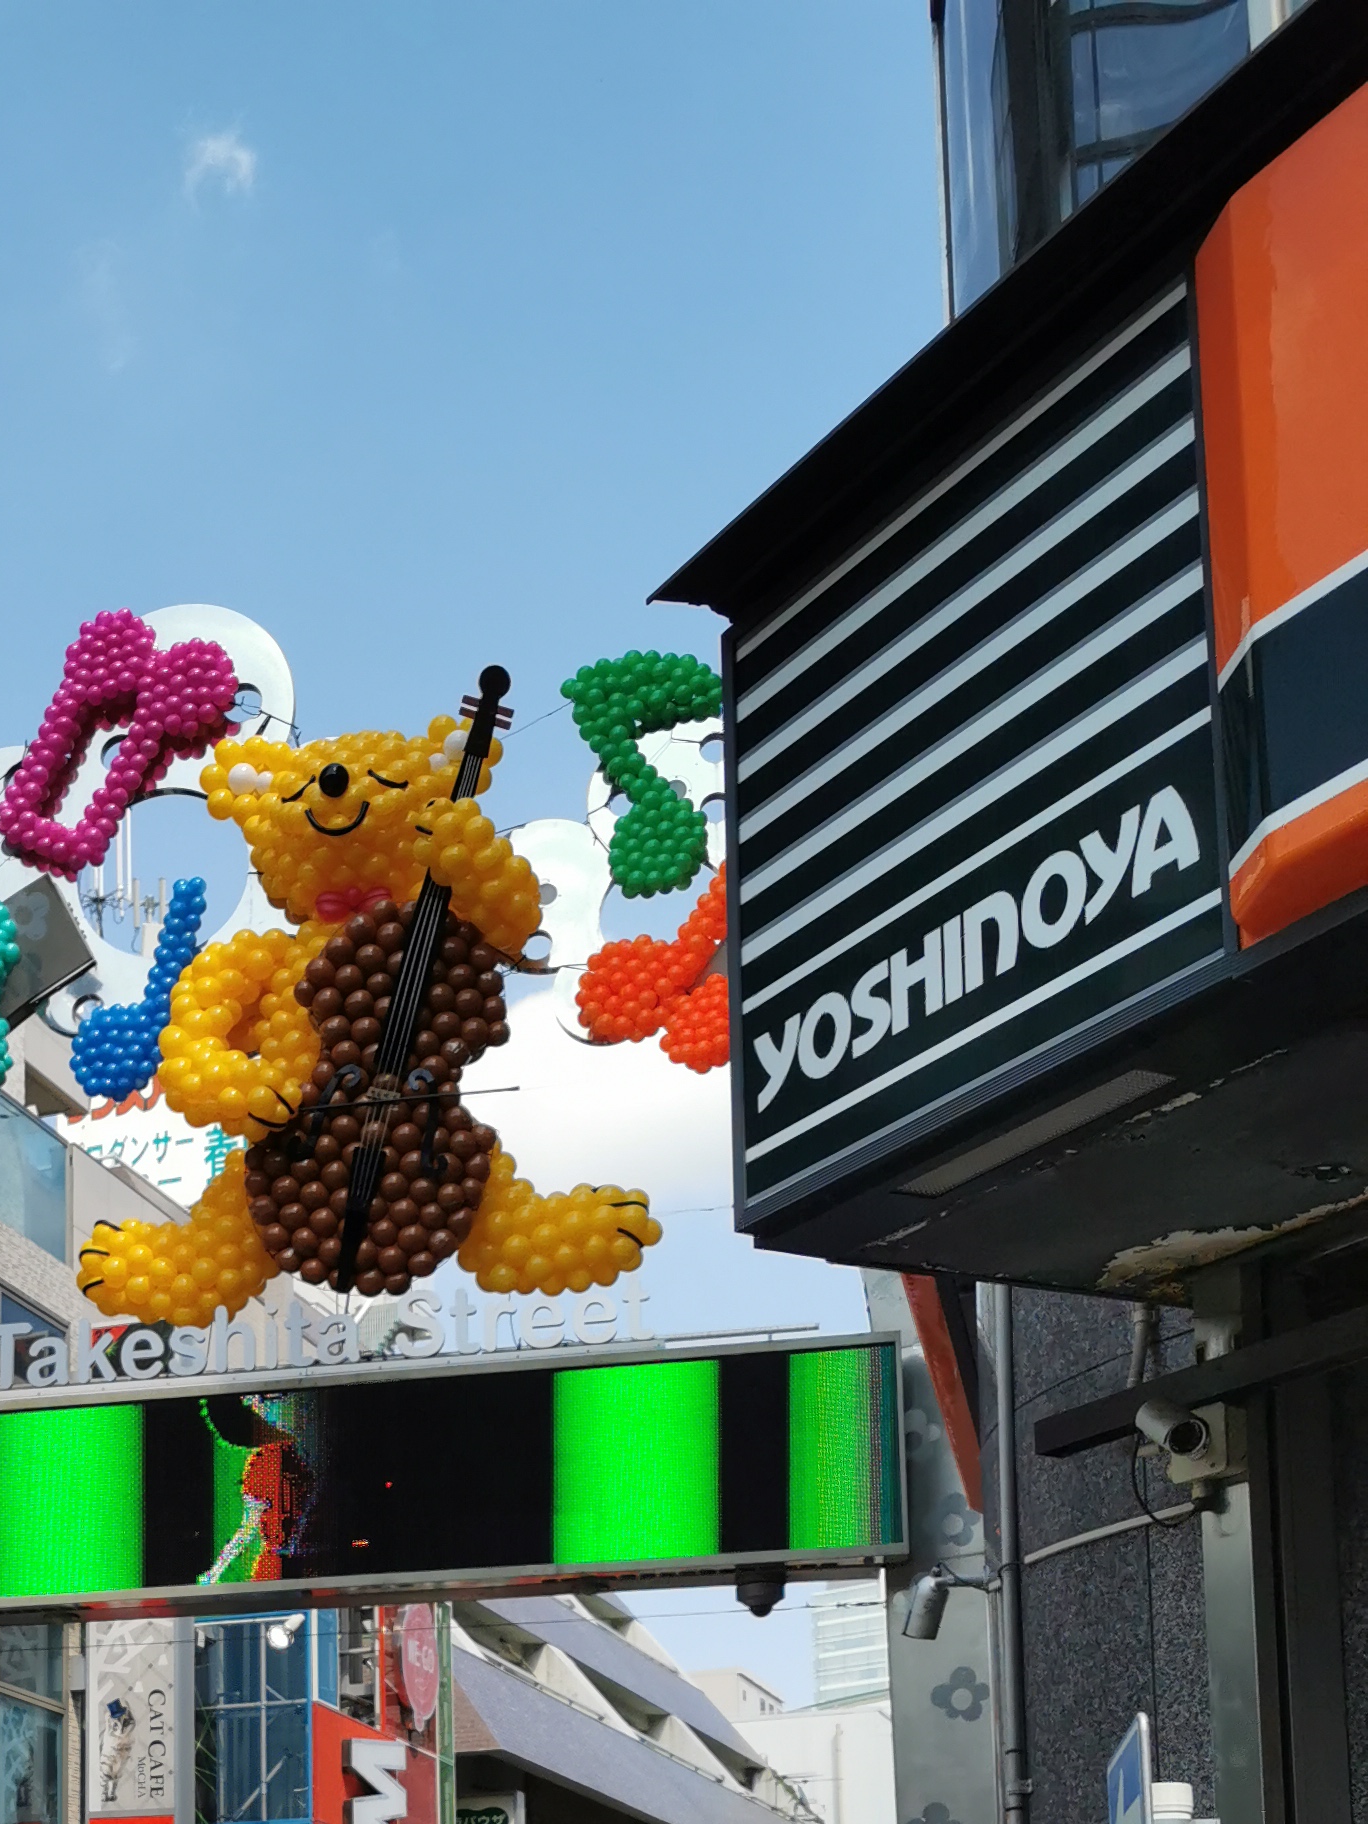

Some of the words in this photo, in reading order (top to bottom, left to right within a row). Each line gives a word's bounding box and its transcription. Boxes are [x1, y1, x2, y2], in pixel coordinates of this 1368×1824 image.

[754, 785, 1201, 1114] YOSHINOYA
[395, 1277, 655, 1358] Street
[148, 1688, 166, 1736] CAT
[148, 1739, 166, 1798] CAFE
